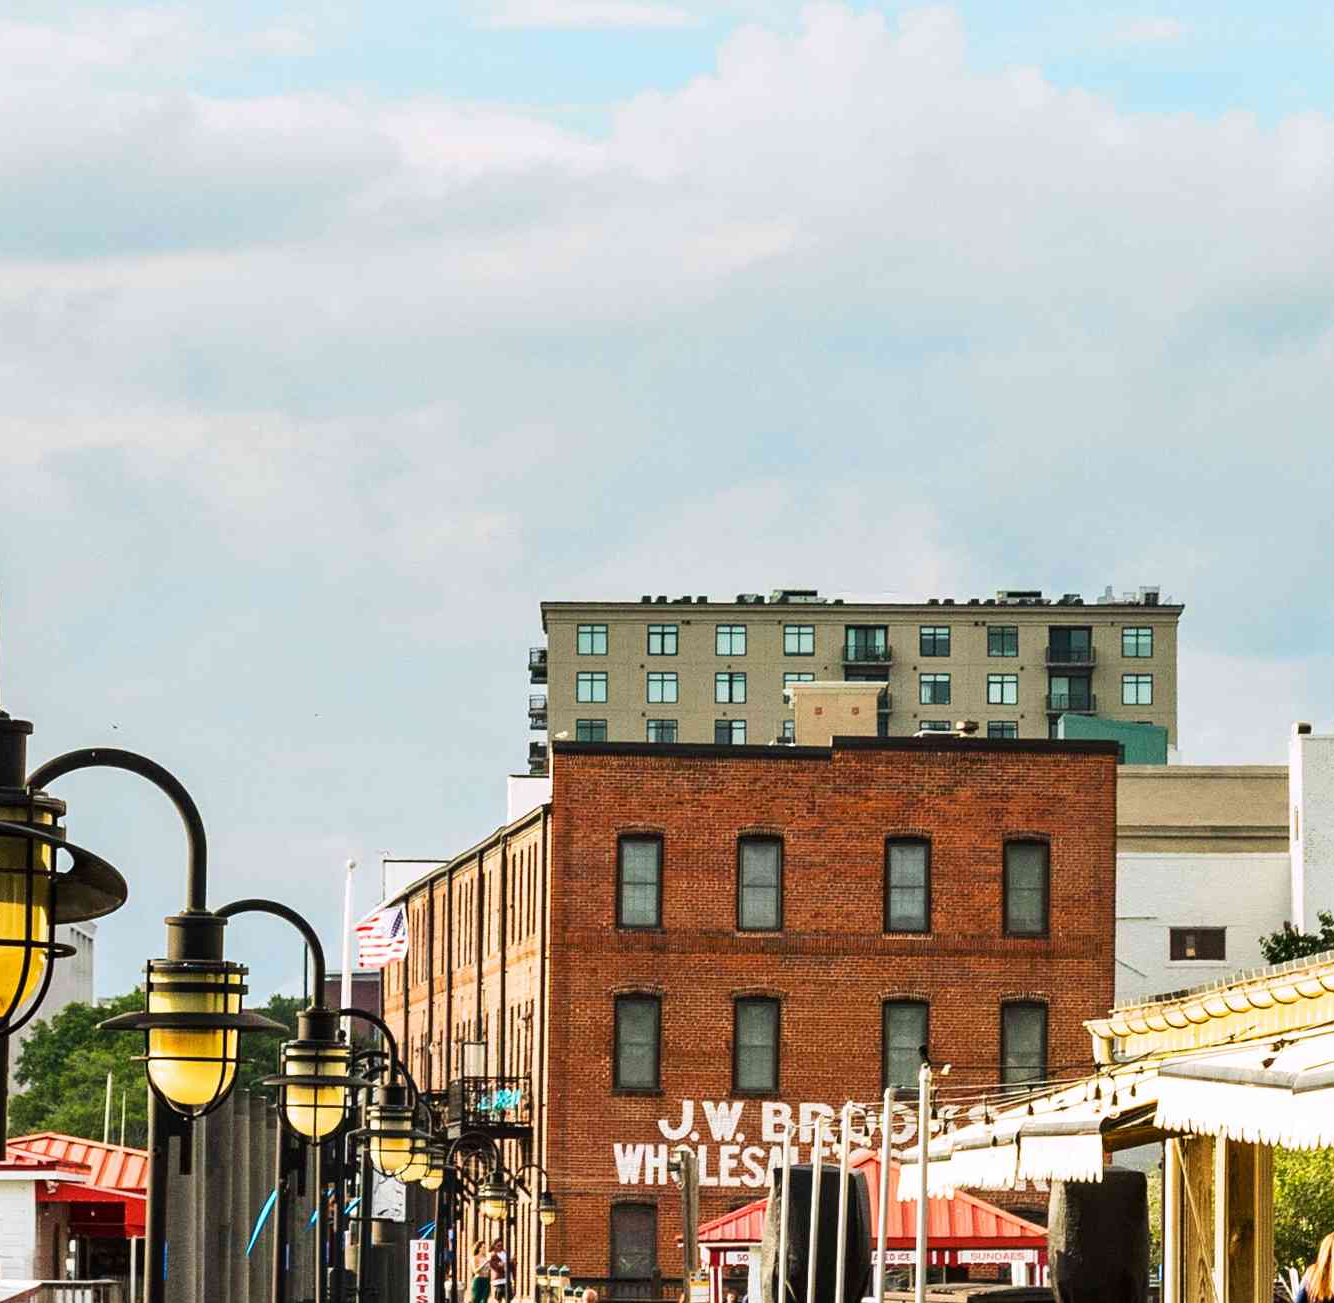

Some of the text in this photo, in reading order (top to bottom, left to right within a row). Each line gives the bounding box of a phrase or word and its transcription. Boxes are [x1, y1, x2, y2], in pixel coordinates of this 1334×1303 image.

[657, 1100, 745, 1142] J.W.
[416, 1252, 429, 1303] BOATS
[970, 1252, 1026, 1261] SUNDAES
